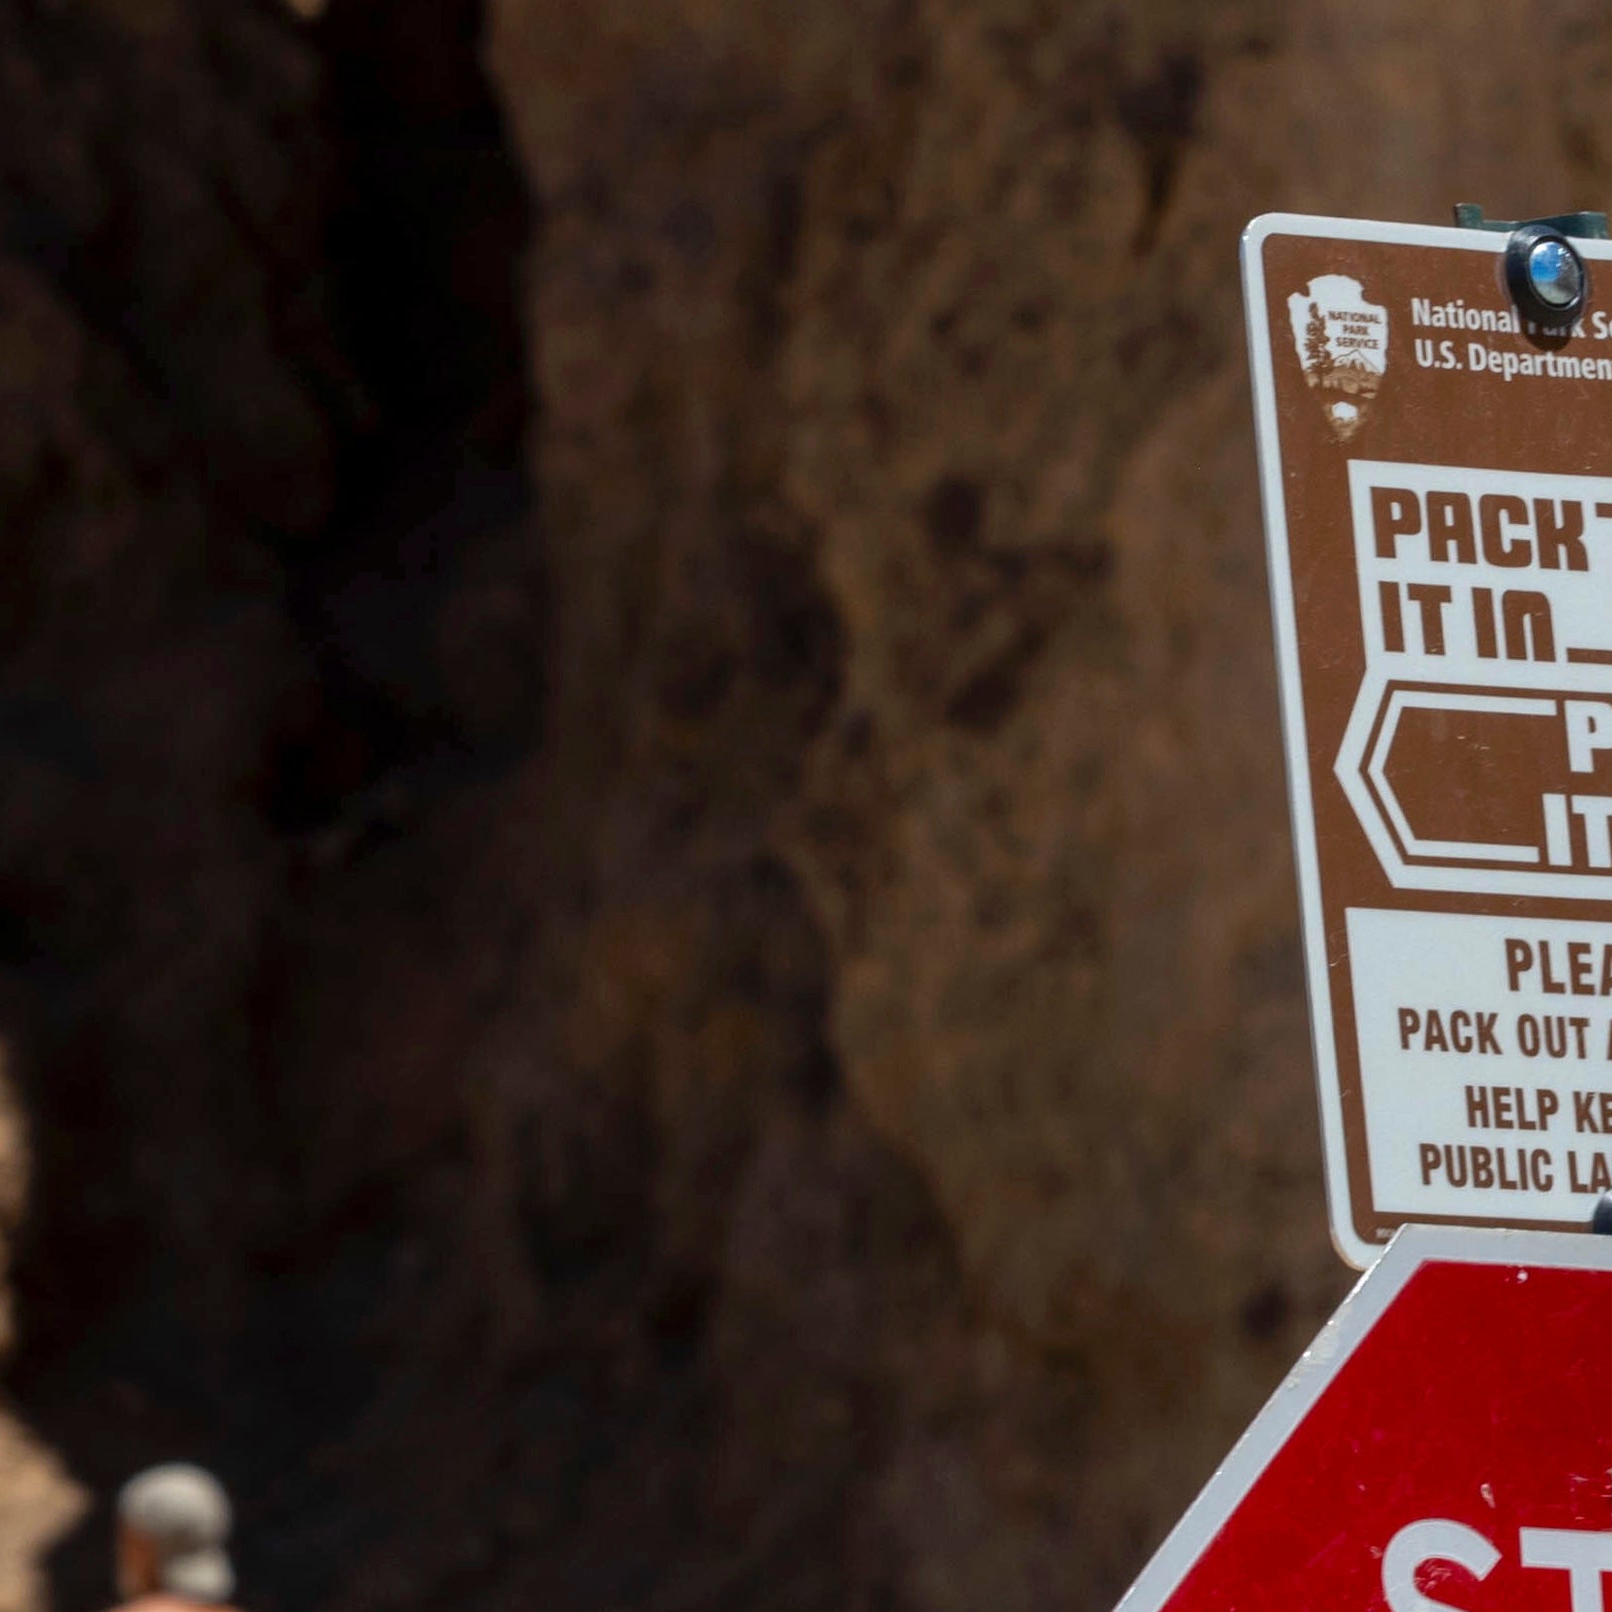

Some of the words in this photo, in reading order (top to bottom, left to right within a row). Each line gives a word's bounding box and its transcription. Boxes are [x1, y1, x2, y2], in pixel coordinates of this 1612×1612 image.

[1328, 310, 1382, 324] NATIONAL
[1342, 324, 1369, 336] PARK
[1412, 297, 1520, 334] National
[1336, 336, 1379, 350] SERVICE
[1414, 338, 1462, 370] U.S.
[1369, 486, 1591, 571] PACK
[1378, 581, 1452, 656] IT
[1397, 1007, 1503, 1056] PACK
[1516, 1014, 1590, 1060] OUT
[1464, 1085, 1560, 1133] HELP
[1419, 1143, 1554, 1193] PUBLIC
